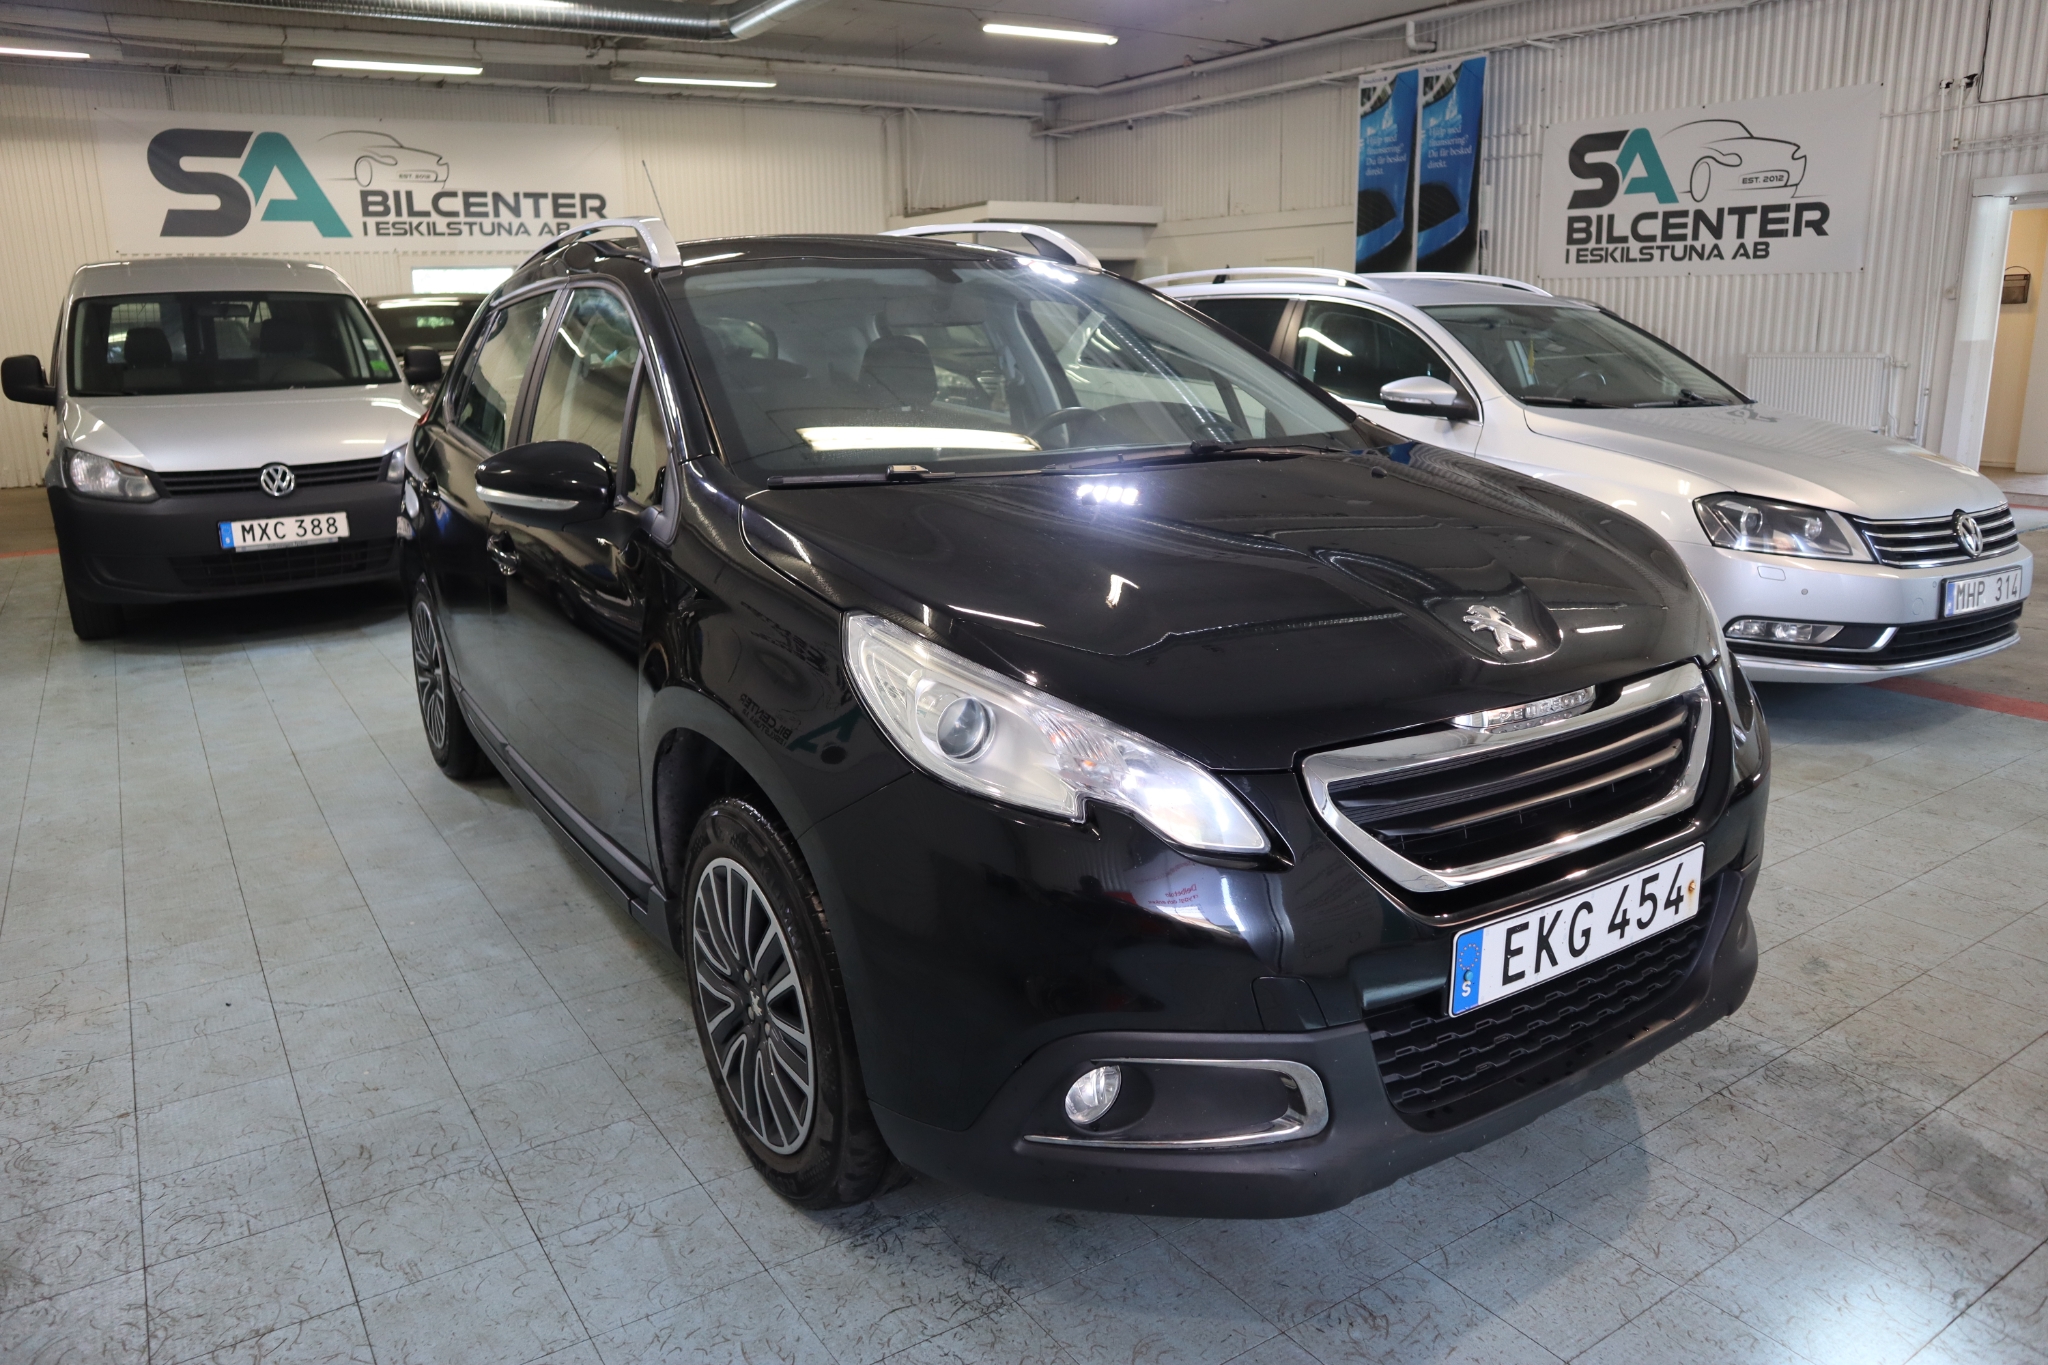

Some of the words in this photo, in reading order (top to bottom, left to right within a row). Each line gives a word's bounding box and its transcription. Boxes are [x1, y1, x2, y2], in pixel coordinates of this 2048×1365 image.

[146, 127, 353, 239] SA
[1567, 127, 1680, 210] SA
[1742, 176, 1761, 185] EST.
[1763, 174, 1785, 183] 2012
[359, 189, 609, 219] BILCENTER
[375, 220, 533, 237] ESKILSTUNA
[1566, 201, 1831, 246] BILCENTER
[1575, 242, 1725, 264] ESKILSTUNA
[1731, 241, 1771, 260] AB
[240, 521, 287, 544] MXC
[294, 516, 339, 538] 388
[1955, 580, 1986, 611] MHP
[1995, 573, 2019, 602] 314
[1501, 900, 1594, 987] EKG
[1607, 861, 1685, 940] 454
[1460, 980, 1472, 998] S
